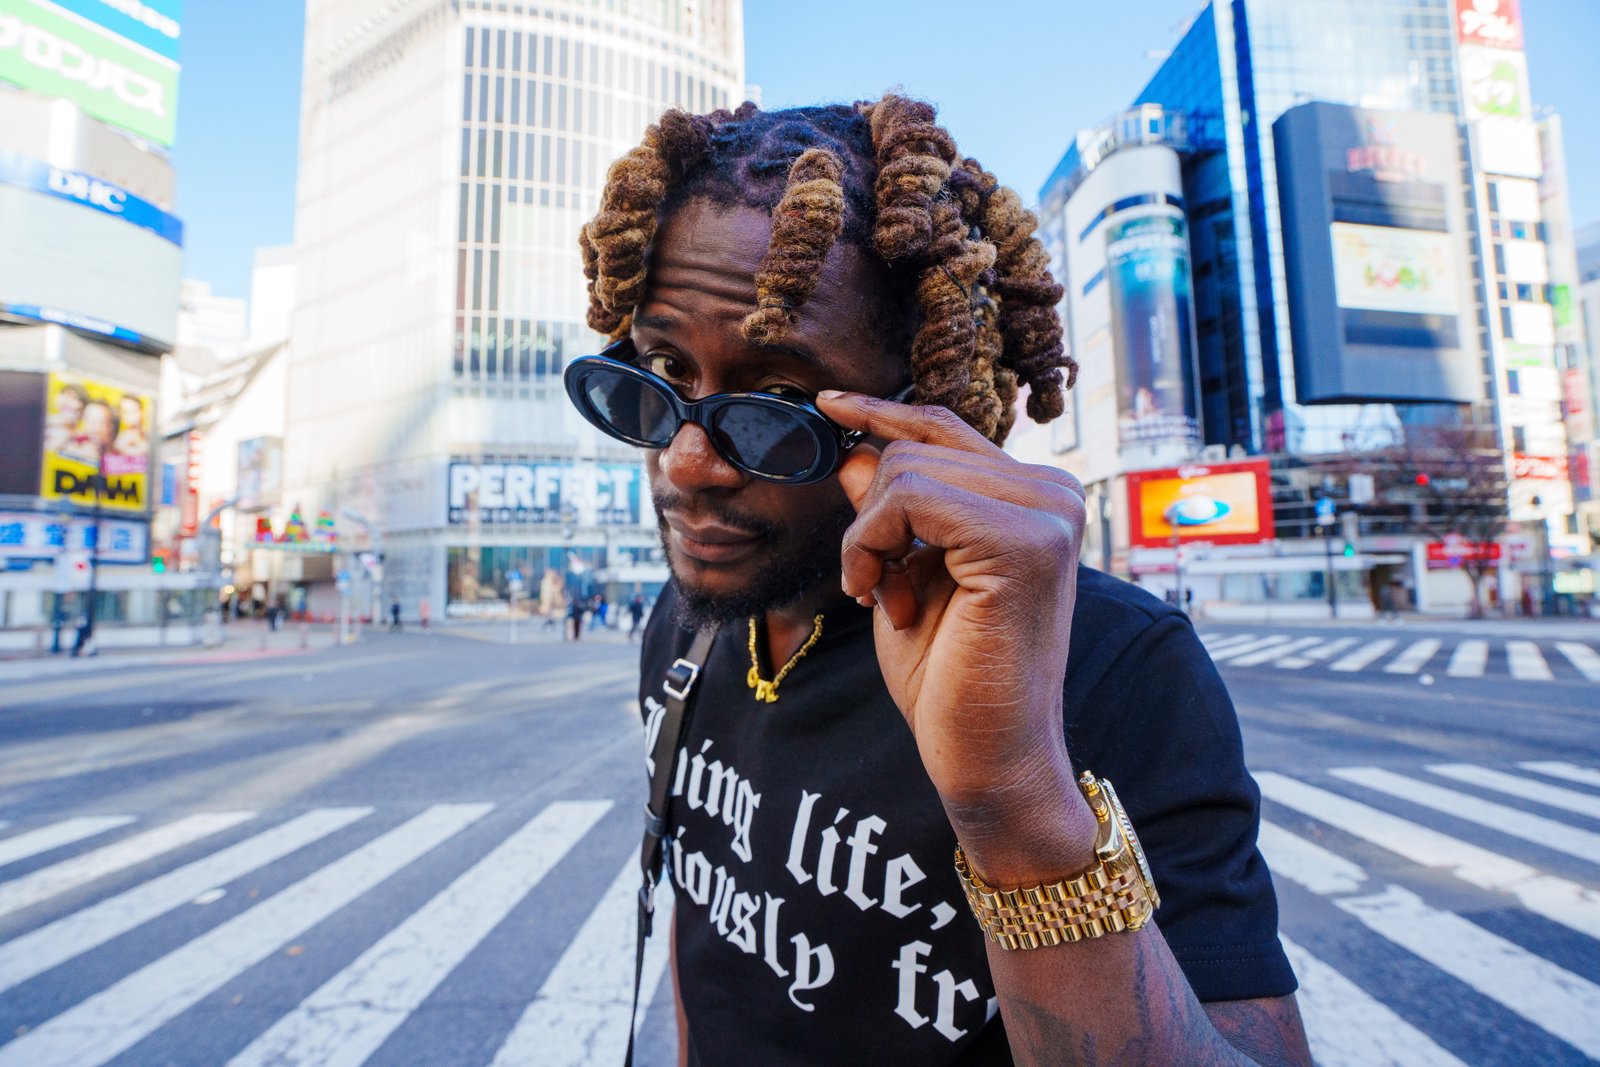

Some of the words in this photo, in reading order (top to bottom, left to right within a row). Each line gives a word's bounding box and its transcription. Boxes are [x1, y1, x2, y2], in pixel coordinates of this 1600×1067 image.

[49, 171, 127, 213] DHC
[450, 463, 634, 511] PERFECT
[785, 789, 957, 931] life,
[672, 825, 835, 1012] iously
[891, 939, 1000, 1042] fr
